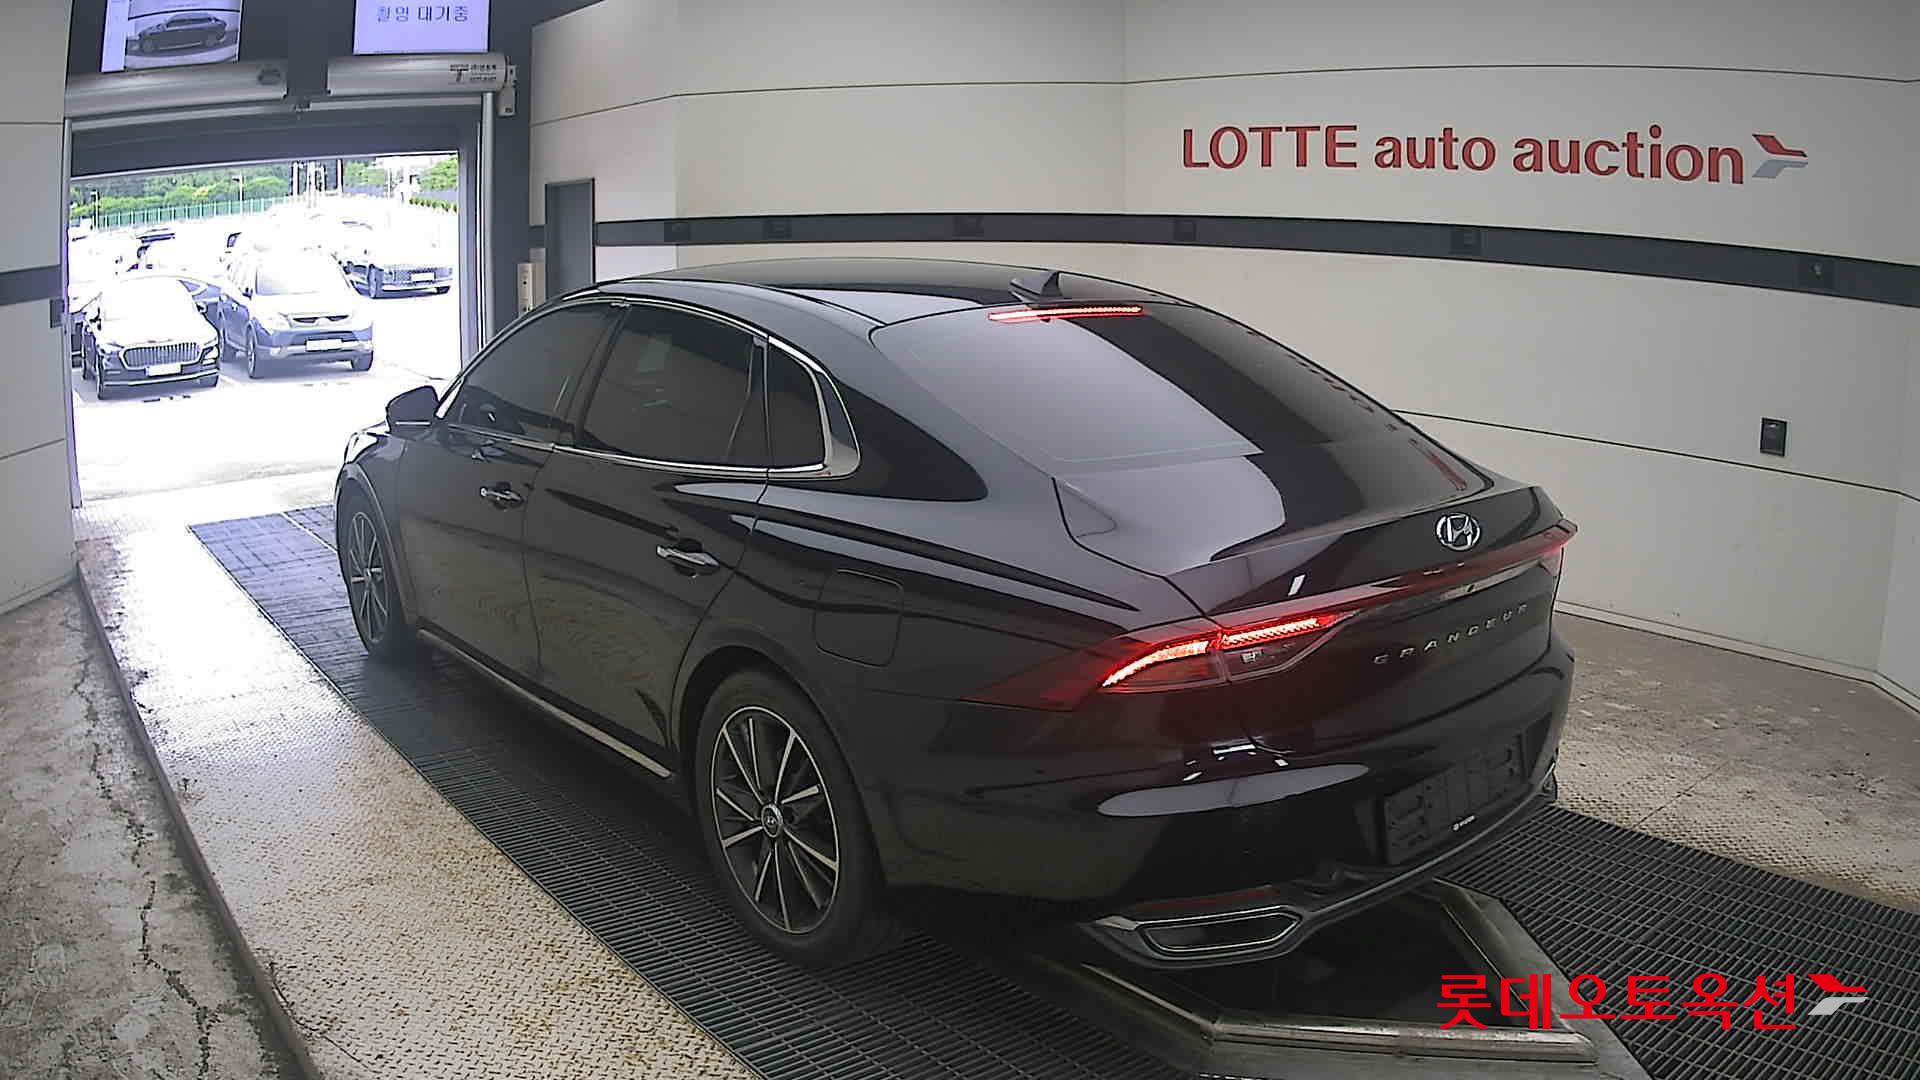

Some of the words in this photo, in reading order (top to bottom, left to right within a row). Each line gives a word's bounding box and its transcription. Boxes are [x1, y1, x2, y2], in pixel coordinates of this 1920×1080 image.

[417, 5, 469, 22] 대기중
[1183, 124, 1359, 169] LOTTE
[1374, 127, 1496, 171] auto
[1512, 125, 1744, 184] auction
[1374, 603, 1529, 664] GRANDEUR
